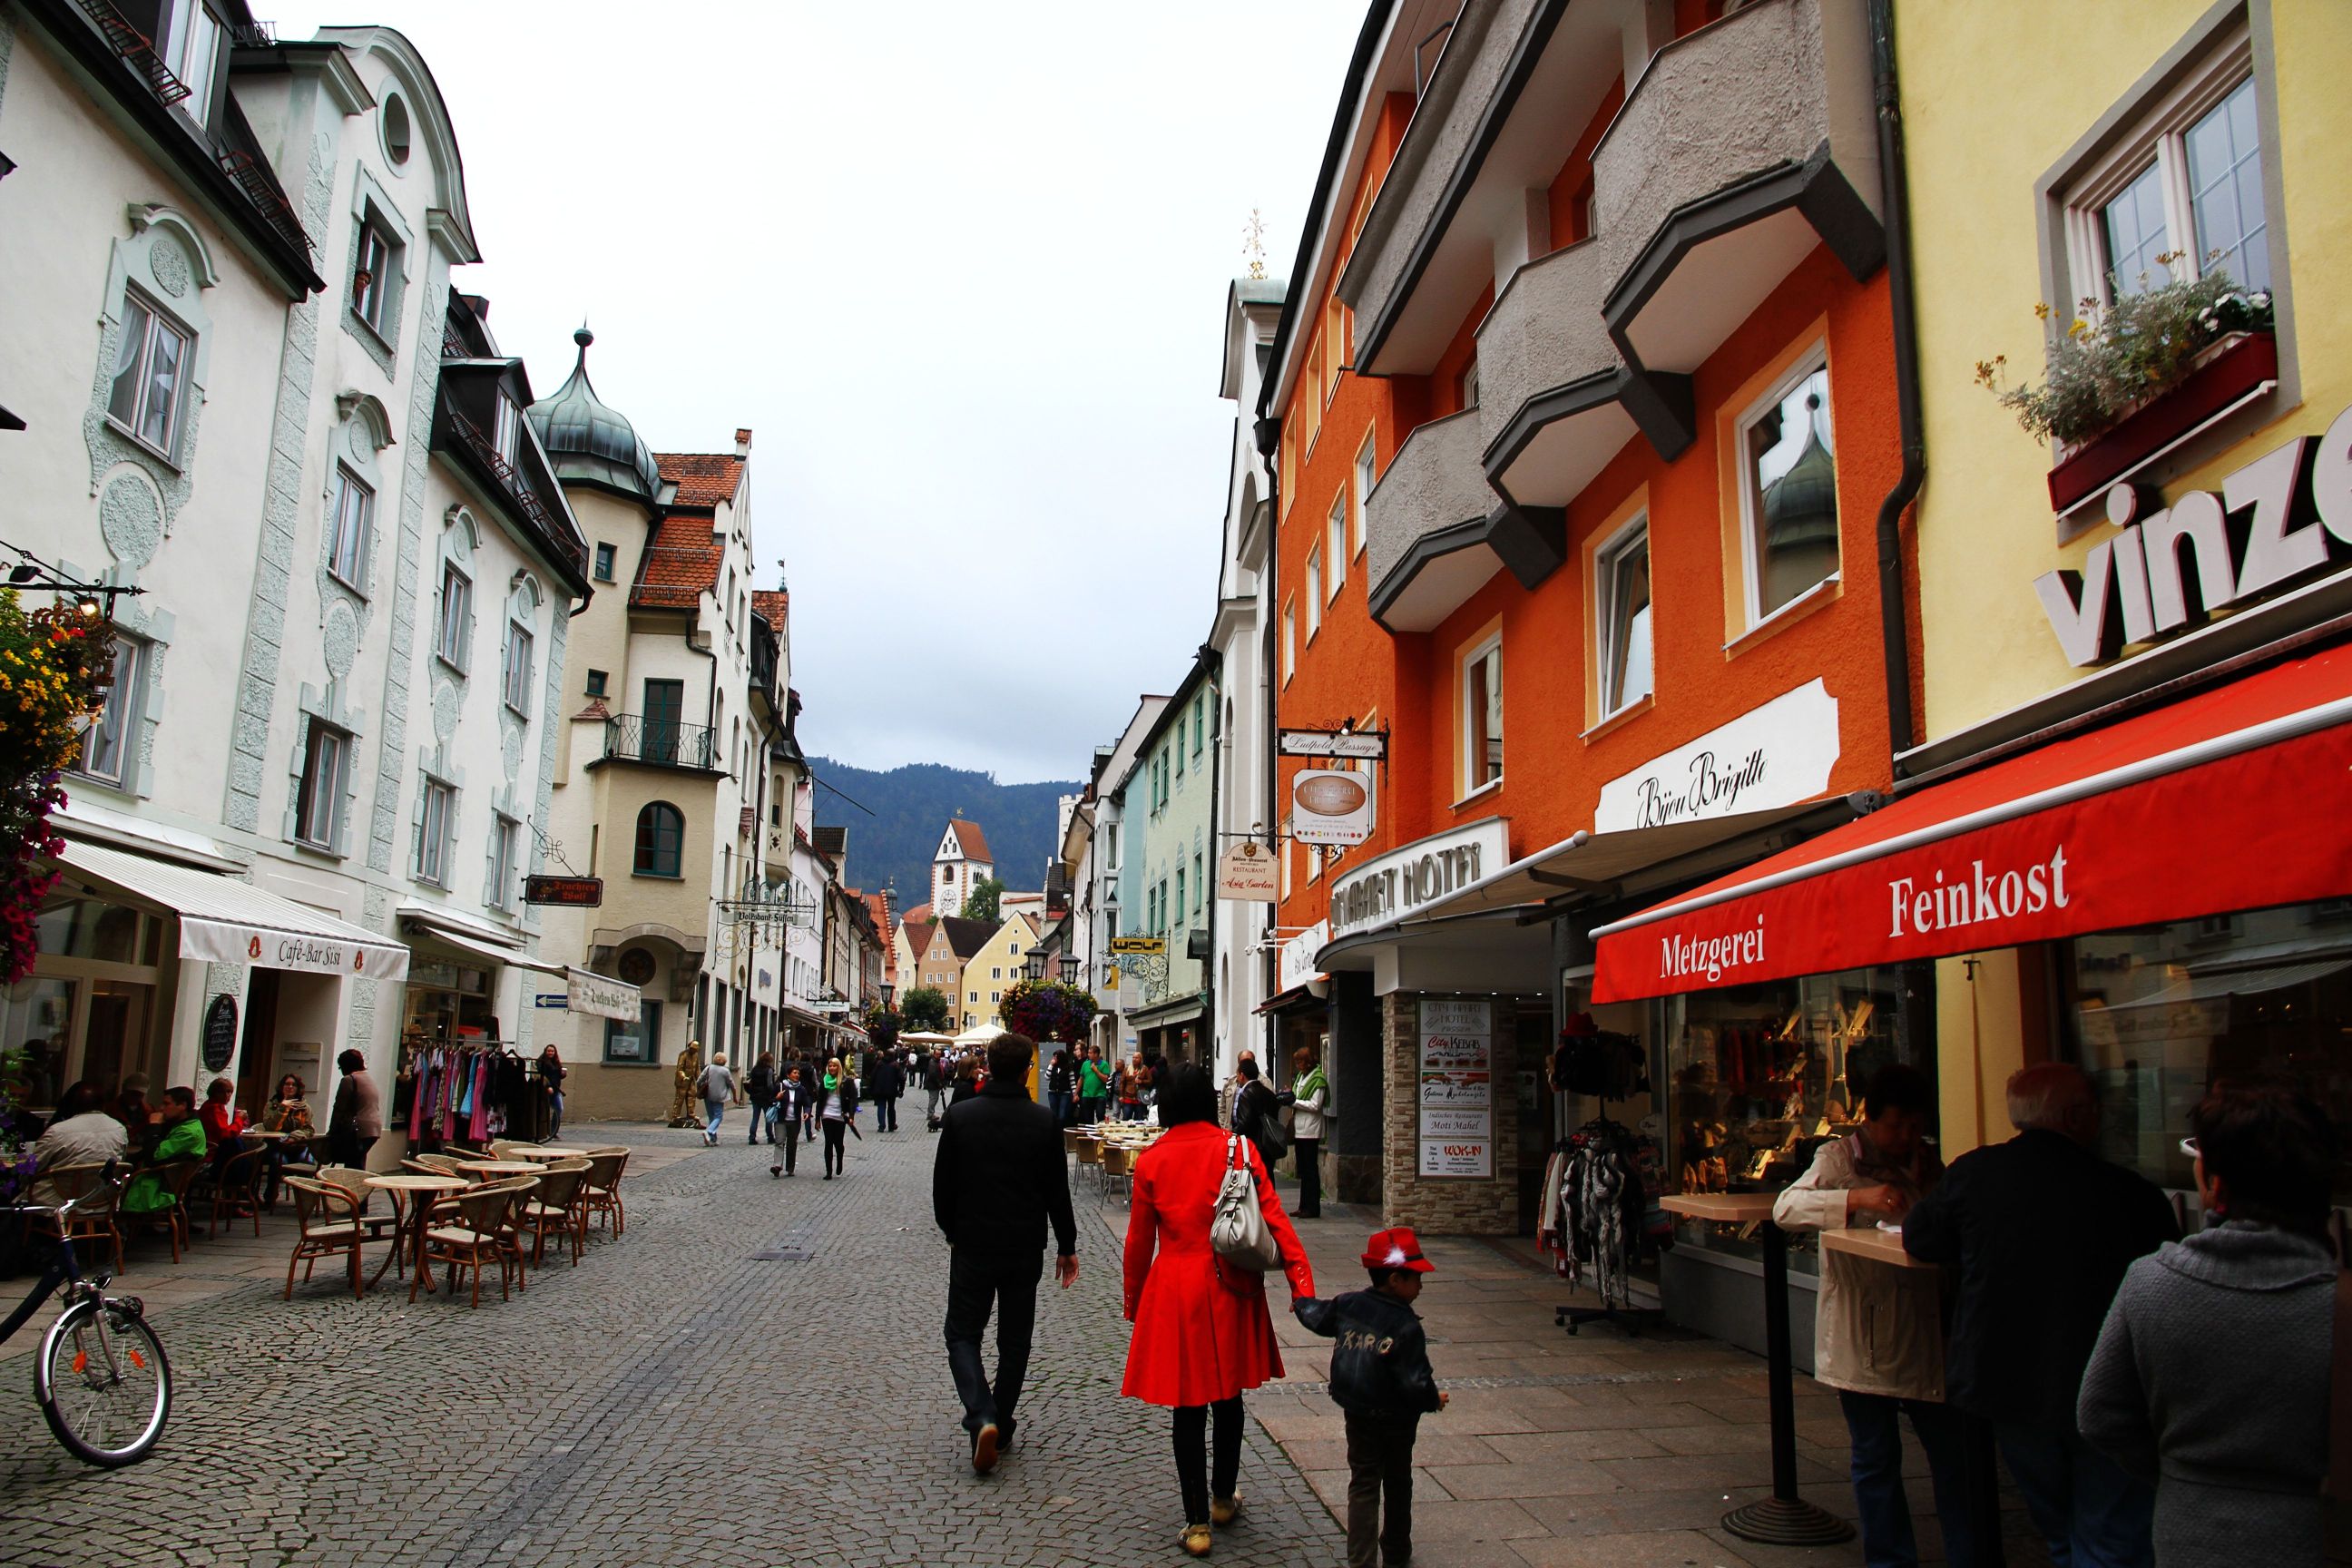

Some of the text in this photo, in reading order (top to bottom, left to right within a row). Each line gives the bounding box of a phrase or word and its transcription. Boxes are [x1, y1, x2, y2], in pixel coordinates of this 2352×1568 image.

[1336, 738, 1377, 755] Passage
[1637, 747, 1769, 829] Bijou Brigitte
[1232, 866, 1267, 875] RESTAURANT
[1221, 877, 1274, 890] Asia Garten
[1889, 844, 2069, 938] Feinkost
[279, 938, 342, 967] Café-Bar Sisi
[1112, 941, 1162, 951] WOLF
[1661, 914, 1765, 983] Metzgerei
[1440, 1014, 1470, 1024] HOTEL
[1427, 1035, 1450, 1050] City
[1444, 1145, 1482, 1156] WOK-IN
